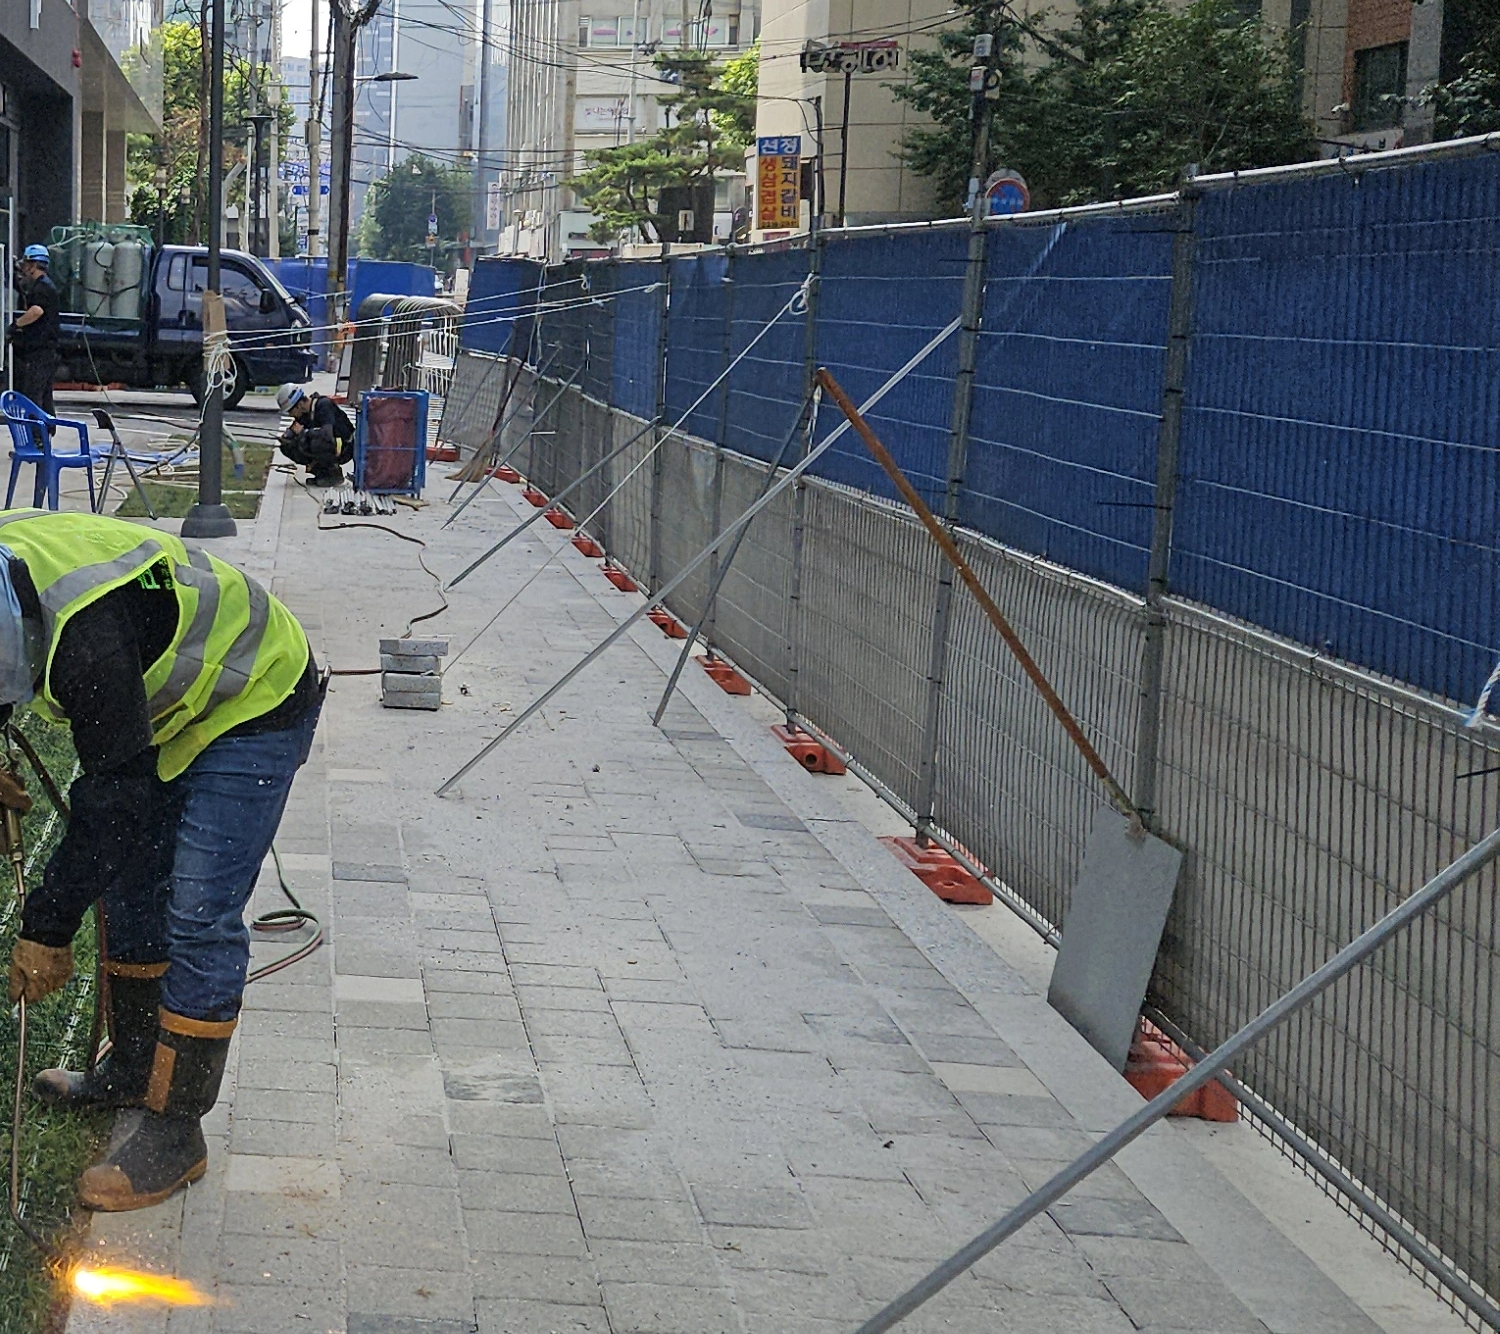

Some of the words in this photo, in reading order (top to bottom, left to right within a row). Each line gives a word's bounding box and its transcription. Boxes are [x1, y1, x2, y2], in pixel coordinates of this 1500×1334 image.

[761, 137, 798, 154] 선정
[761, 157, 778, 220] 생삼겹살
[781, 156, 798, 219] 돼지갈비
